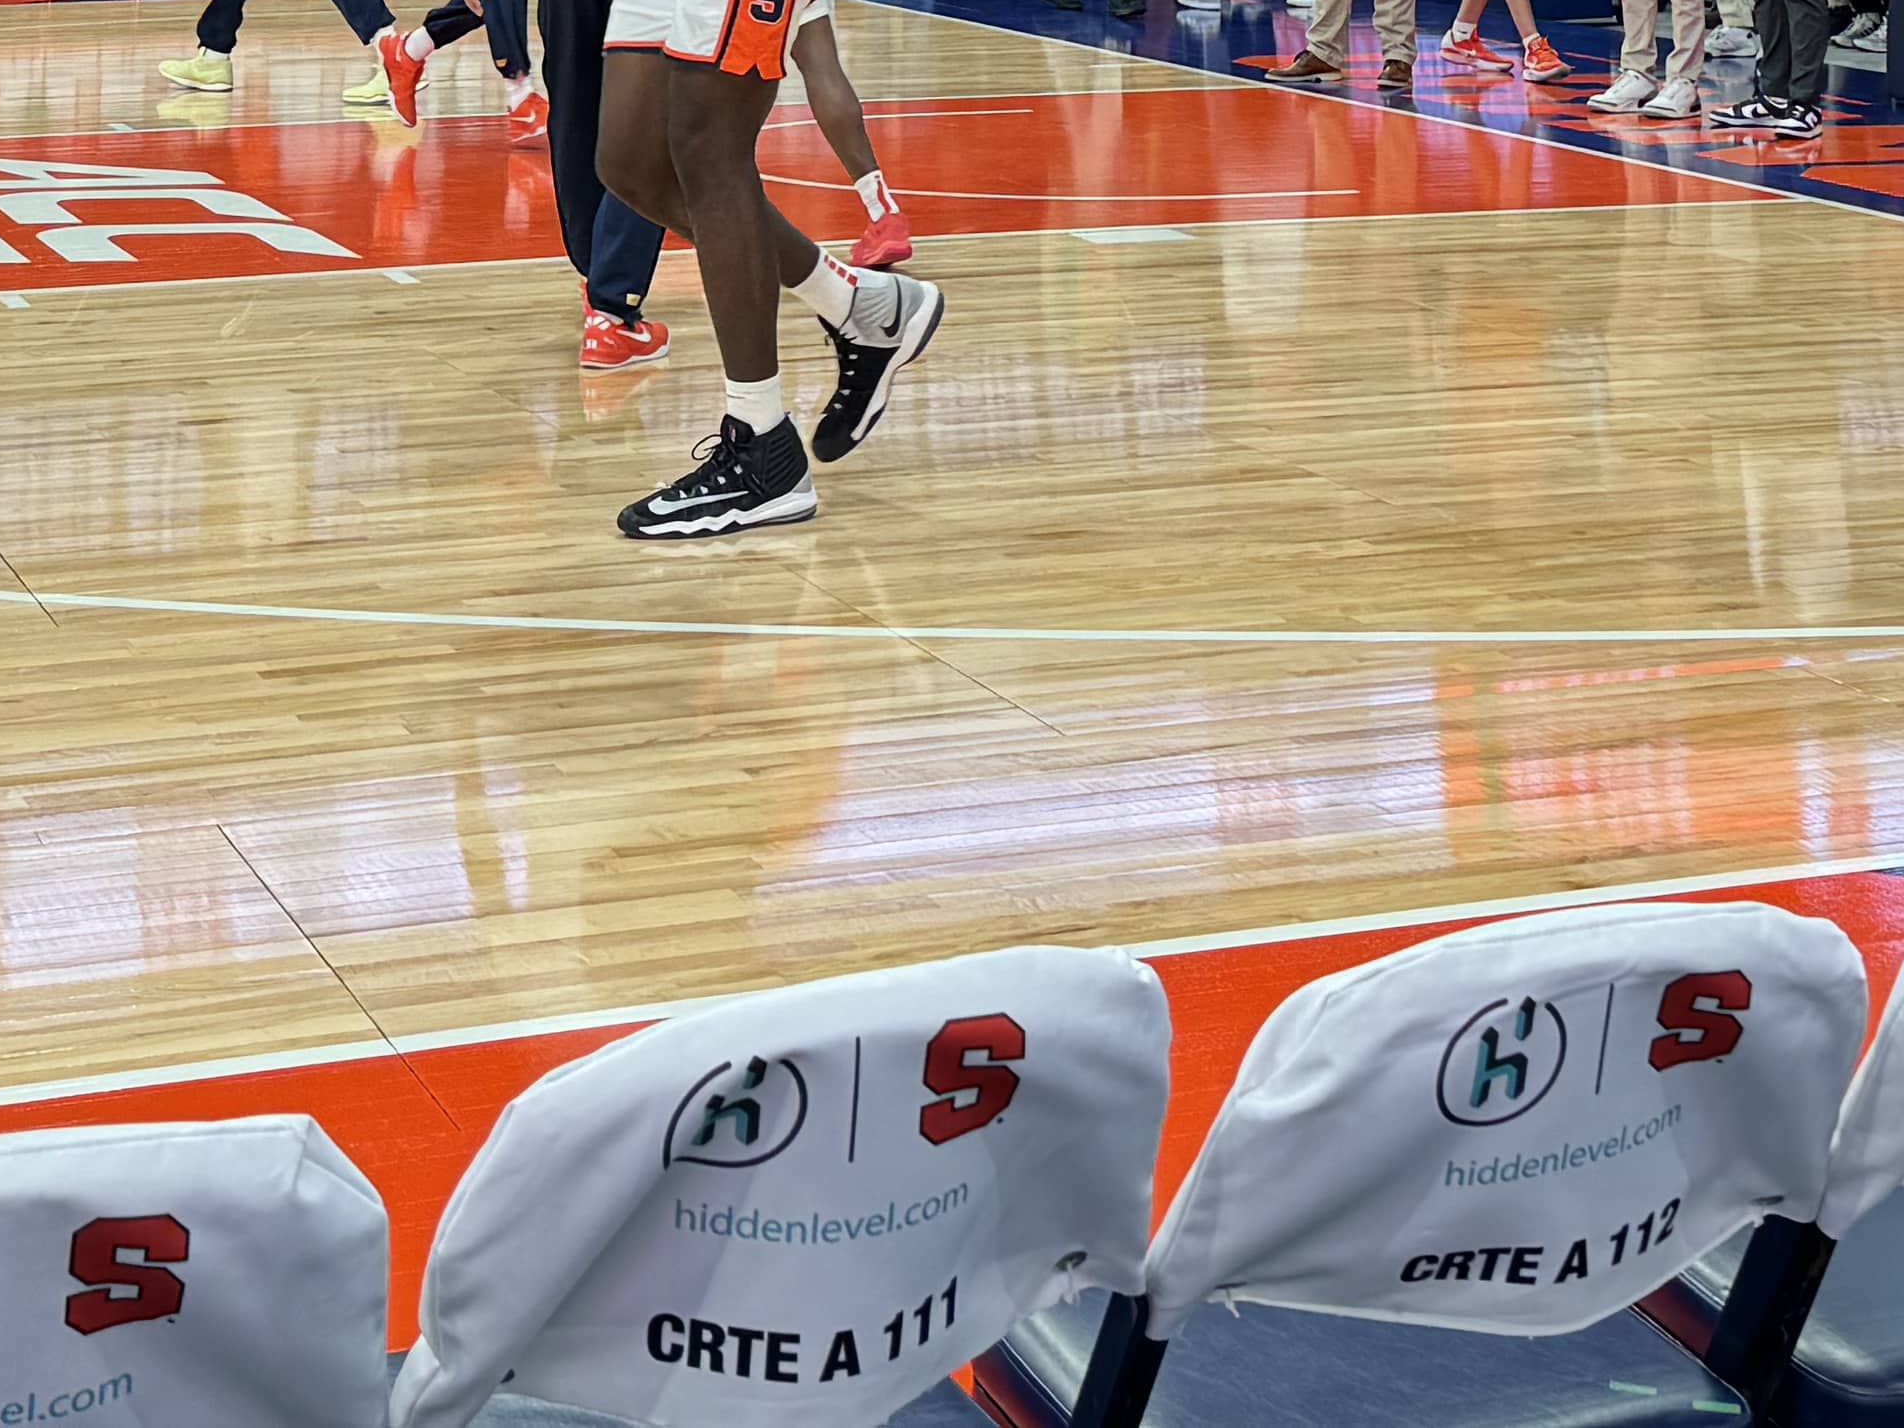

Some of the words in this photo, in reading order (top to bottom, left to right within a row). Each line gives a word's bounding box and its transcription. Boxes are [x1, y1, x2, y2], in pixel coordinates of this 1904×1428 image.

[1648, 968, 1753, 1073] S
[918, 1011, 1027, 1146] S
[1444, 1100, 1684, 1190] hiddenlevel.com
[674, 1178, 969, 1247] hiddenlevel.com
[1398, 1243, 1545, 1287] CRTE
[1553, 1238, 1590, 1285] A
[1608, 1196, 1683, 1267] 112
[64, 1212, 191, 1337] S
[646, 1309, 801, 1385] CRTE
[817, 1327, 863, 1383] A
[883, 1275, 959, 1362] 111
